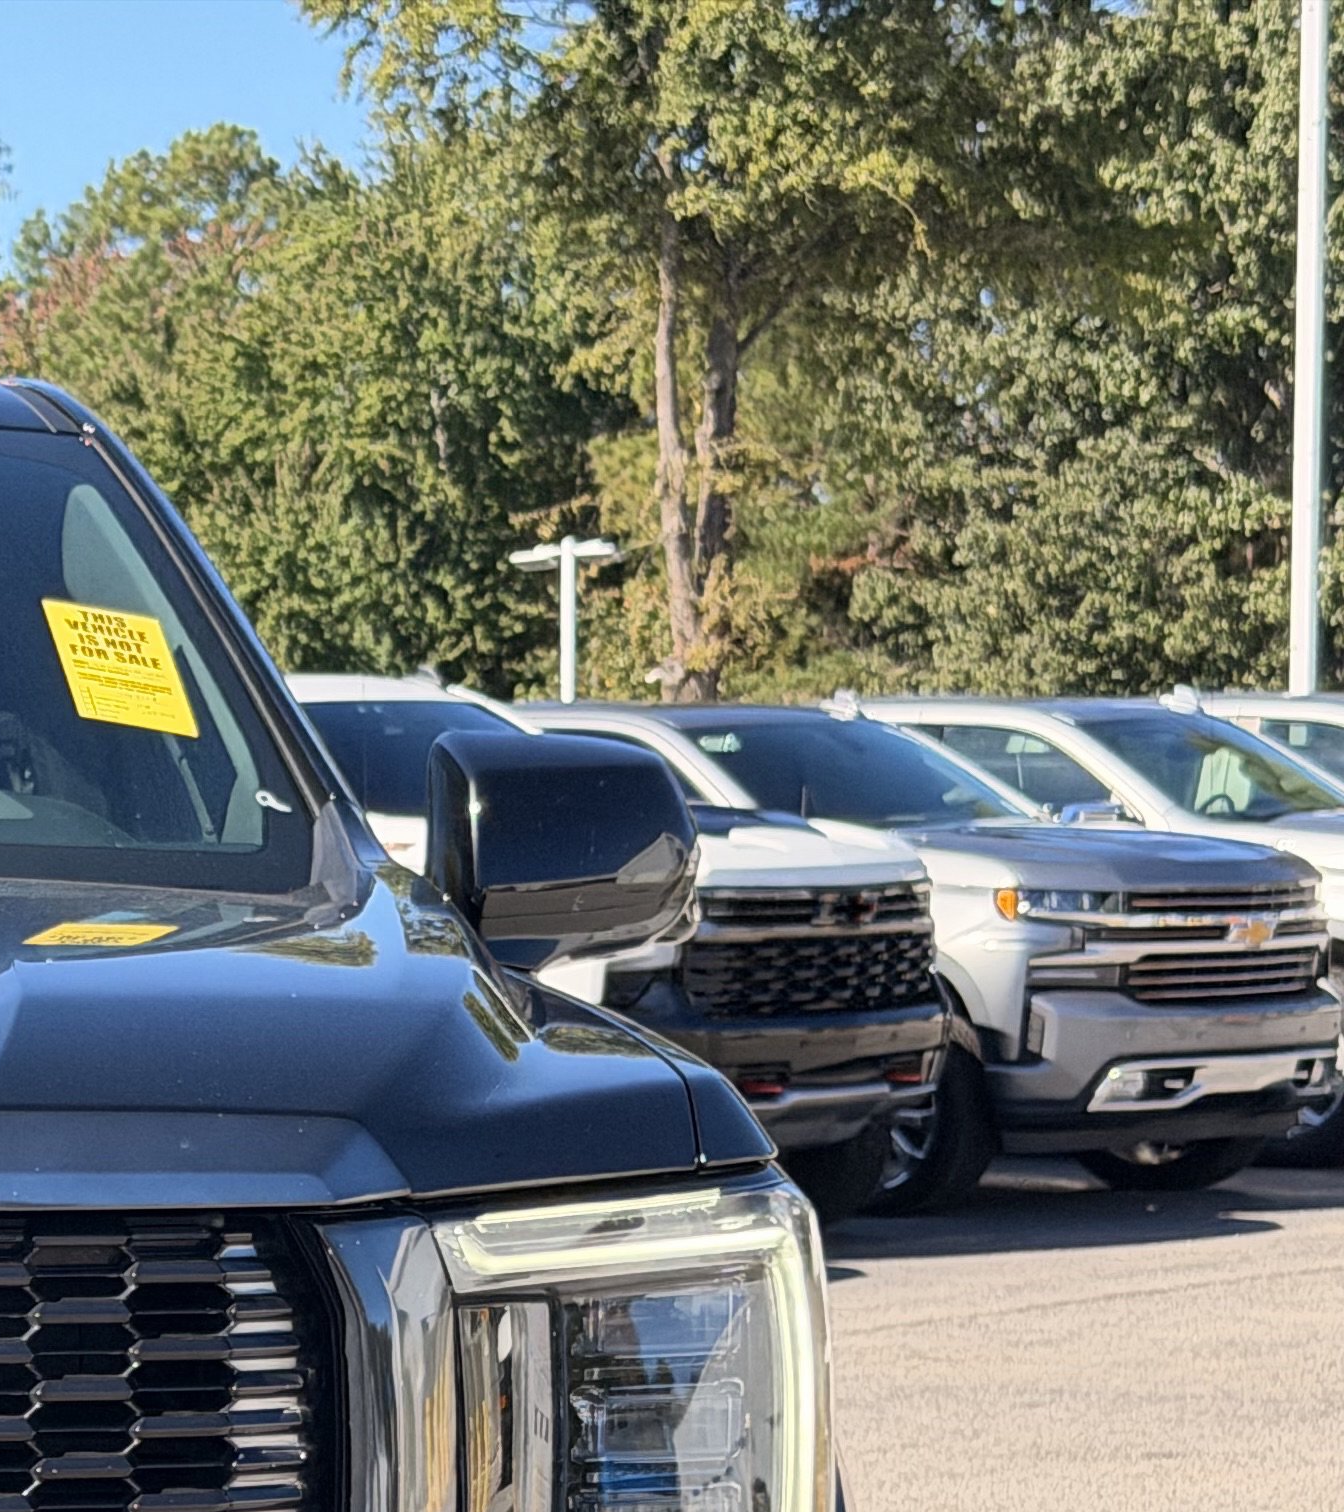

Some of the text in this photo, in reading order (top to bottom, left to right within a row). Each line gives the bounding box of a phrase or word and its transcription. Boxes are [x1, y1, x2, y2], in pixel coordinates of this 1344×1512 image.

[64, 618, 150, 644] VEHICLE
[78, 610, 127, 628] THIS
[78, 632, 142, 654] IS NOT
[69, 643, 110, 661] FOR
[114, 651, 162, 671] SALE
